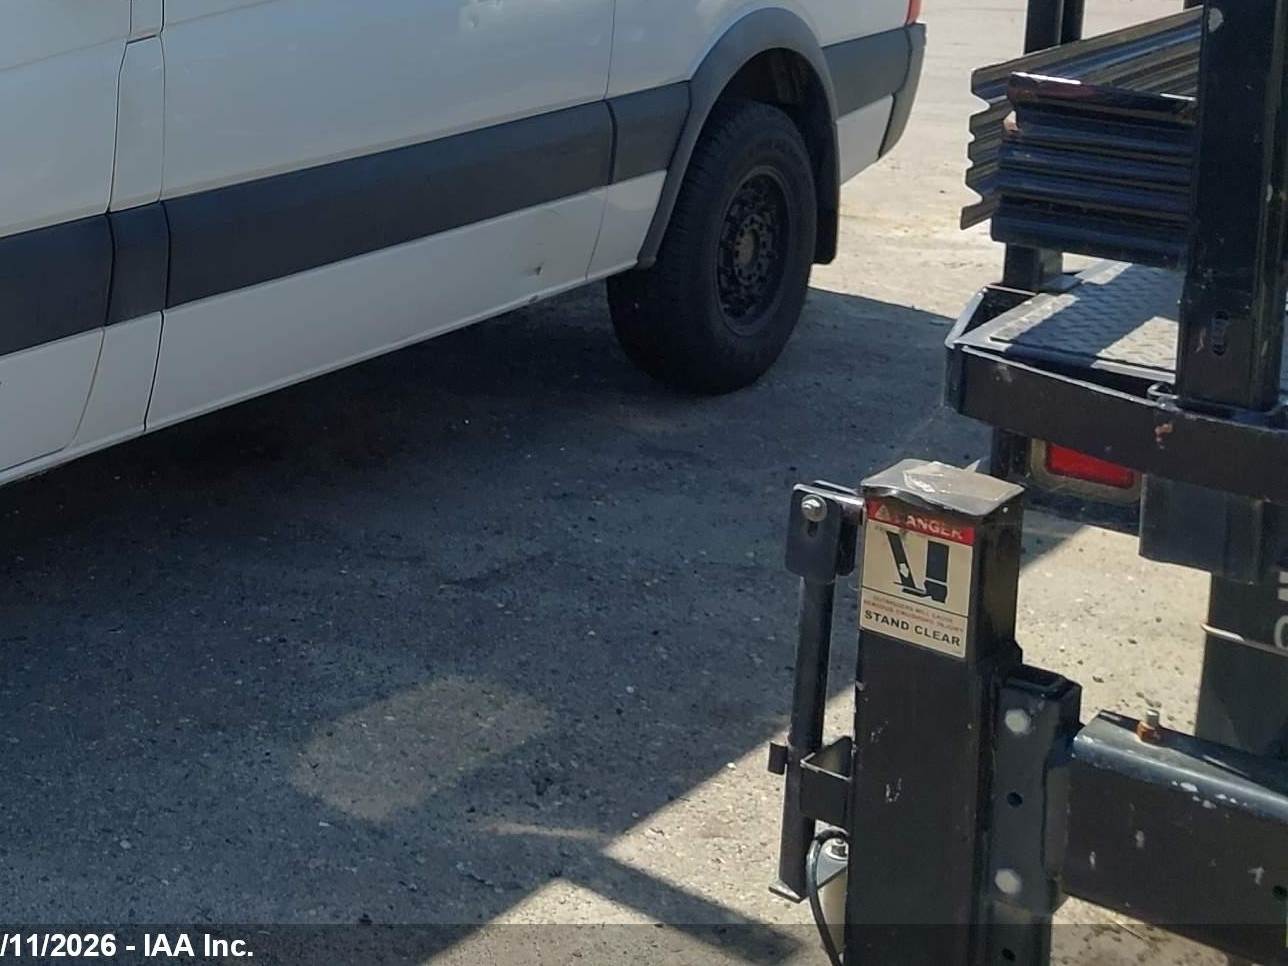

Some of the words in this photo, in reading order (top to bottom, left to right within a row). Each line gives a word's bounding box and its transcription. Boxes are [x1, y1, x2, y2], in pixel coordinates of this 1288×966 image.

[897, 513, 963, 539] ANGER
[864, 610, 909, 630] STAND
[915, 625, 961, 646] CLEAR
